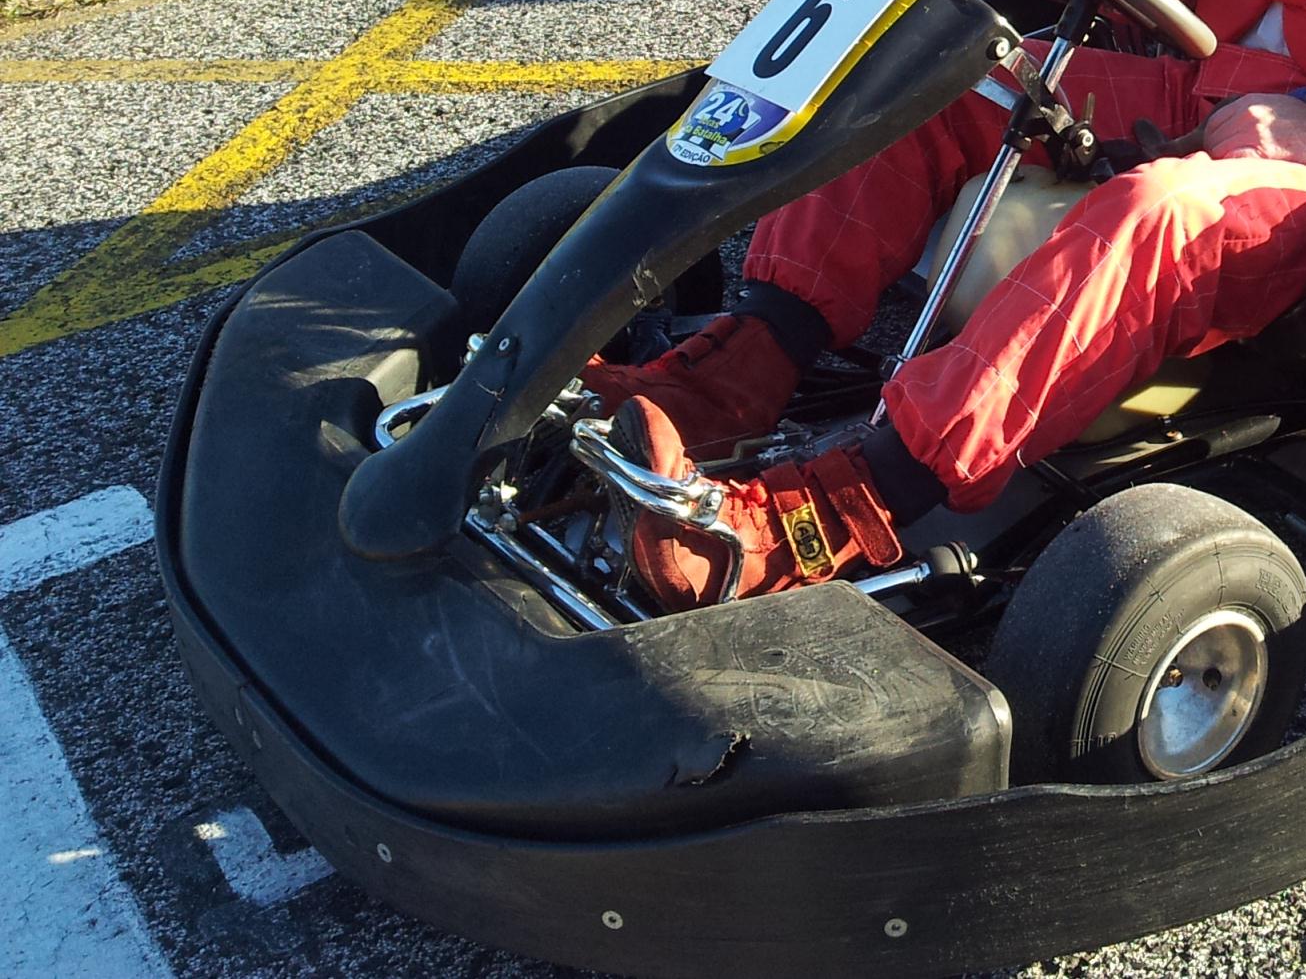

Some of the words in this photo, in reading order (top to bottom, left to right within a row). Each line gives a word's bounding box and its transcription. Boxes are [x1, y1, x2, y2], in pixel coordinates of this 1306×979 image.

[695, 93, 743, 126] 24
[693, 125, 728, 146] Batalha
[681, 148, 711, 163] EDIÇÃO
